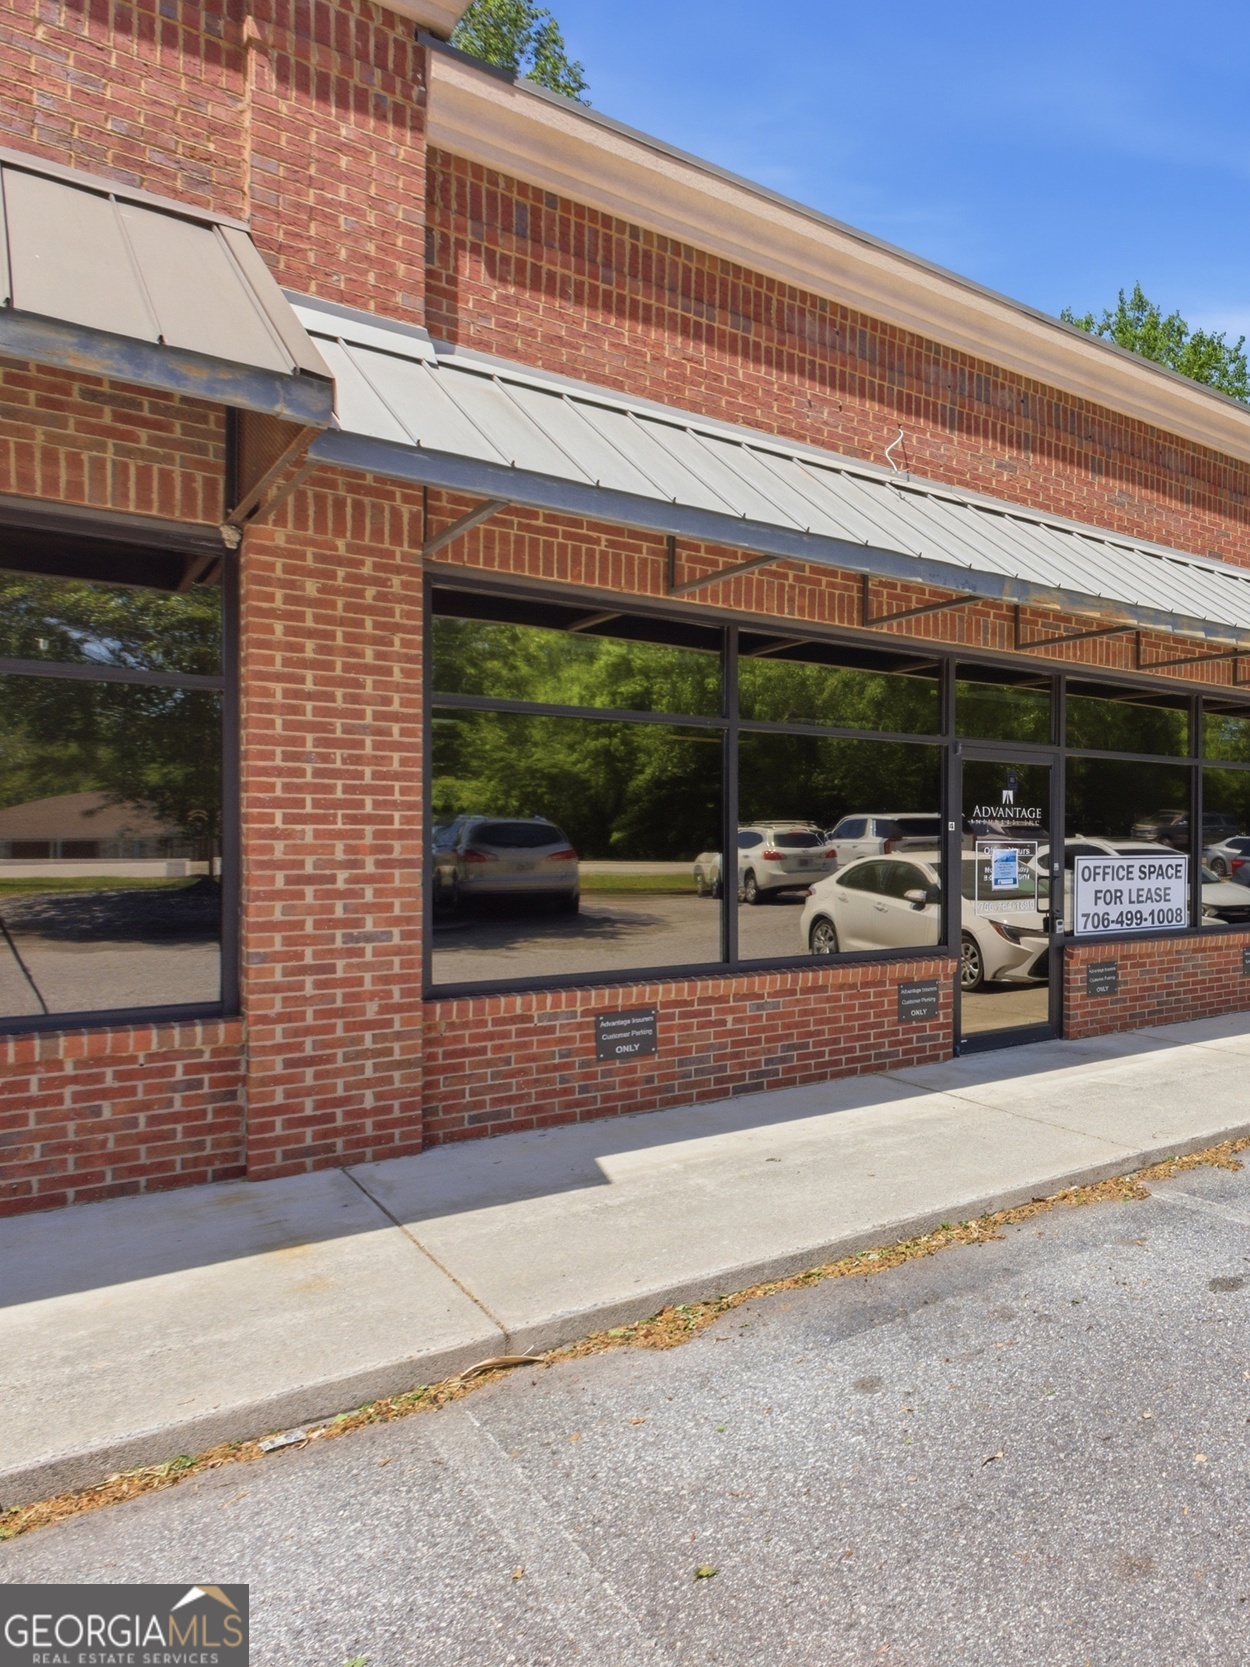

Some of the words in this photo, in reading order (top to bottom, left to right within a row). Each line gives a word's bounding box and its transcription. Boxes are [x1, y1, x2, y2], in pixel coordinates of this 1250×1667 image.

[973, 804, 1042, 819] ADVANTAGE
[1081, 865, 1135, 882] OFFICE
[1138, 864, 1183, 880] SPACE
[1094, 889, 1123, 906] FOR
[1128, 887, 1171, 904] LEASE
[1081, 907, 1183, 929] 706-499-1008
[600, 1019, 631, 1027] Advantage
[602, 1032, 630, 1040] Customer
[615, 1043, 640, 1053] ONLY
